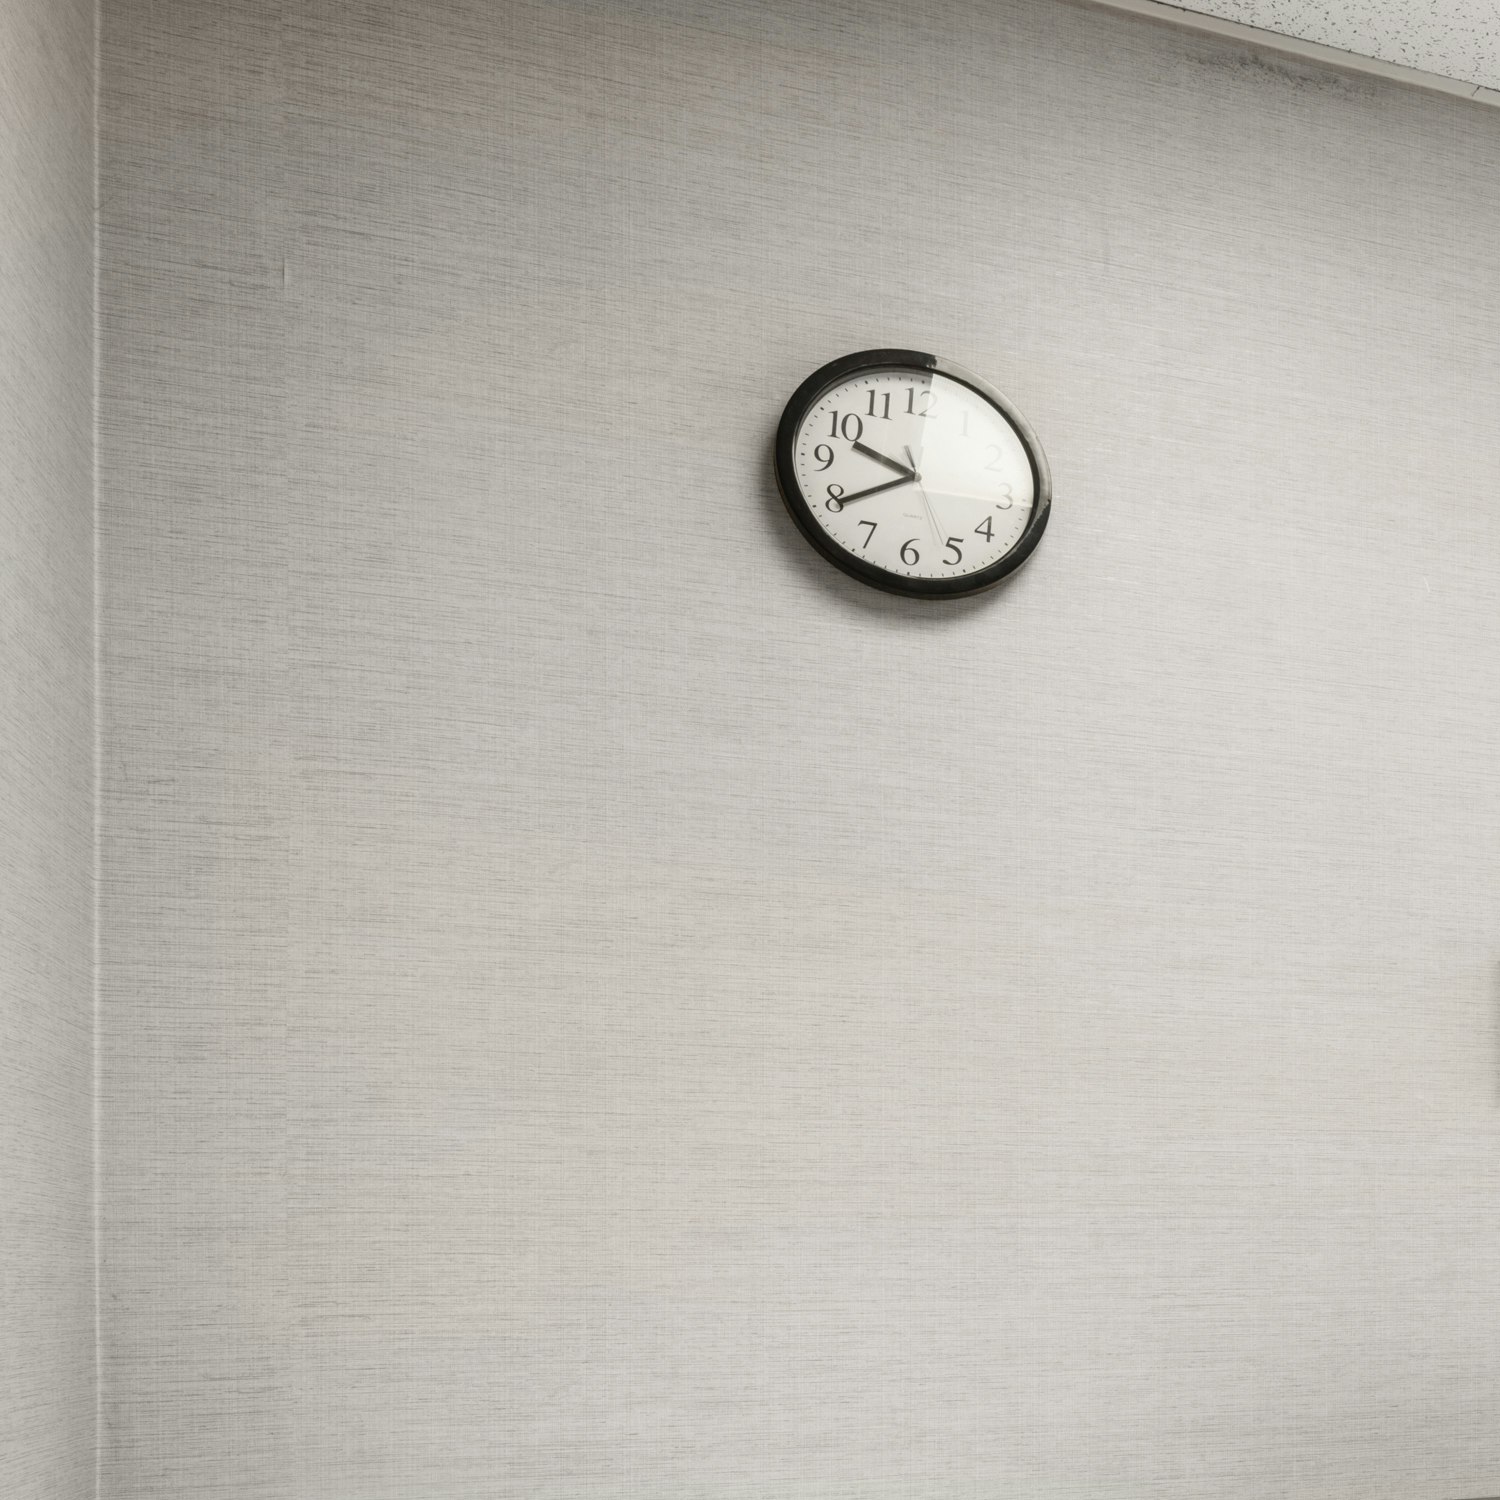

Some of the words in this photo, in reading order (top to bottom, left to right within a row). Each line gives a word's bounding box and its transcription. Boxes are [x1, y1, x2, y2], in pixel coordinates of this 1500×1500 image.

[865, 390, 892, 420] 11
[904, 388, 938, 419] 12
[828, 410, 863, 441] 10
[813, 444, 834, 471] 9
[985, 445, 1003, 472] 2
[825, 484, 844, 513] 8
[996, 483, 1013, 509] 3
[858, 520, 878, 549] 7
[974, 516, 994, 542] 4
[900, 539, 920, 565] 6
[943, 537, 964, 565] 5
